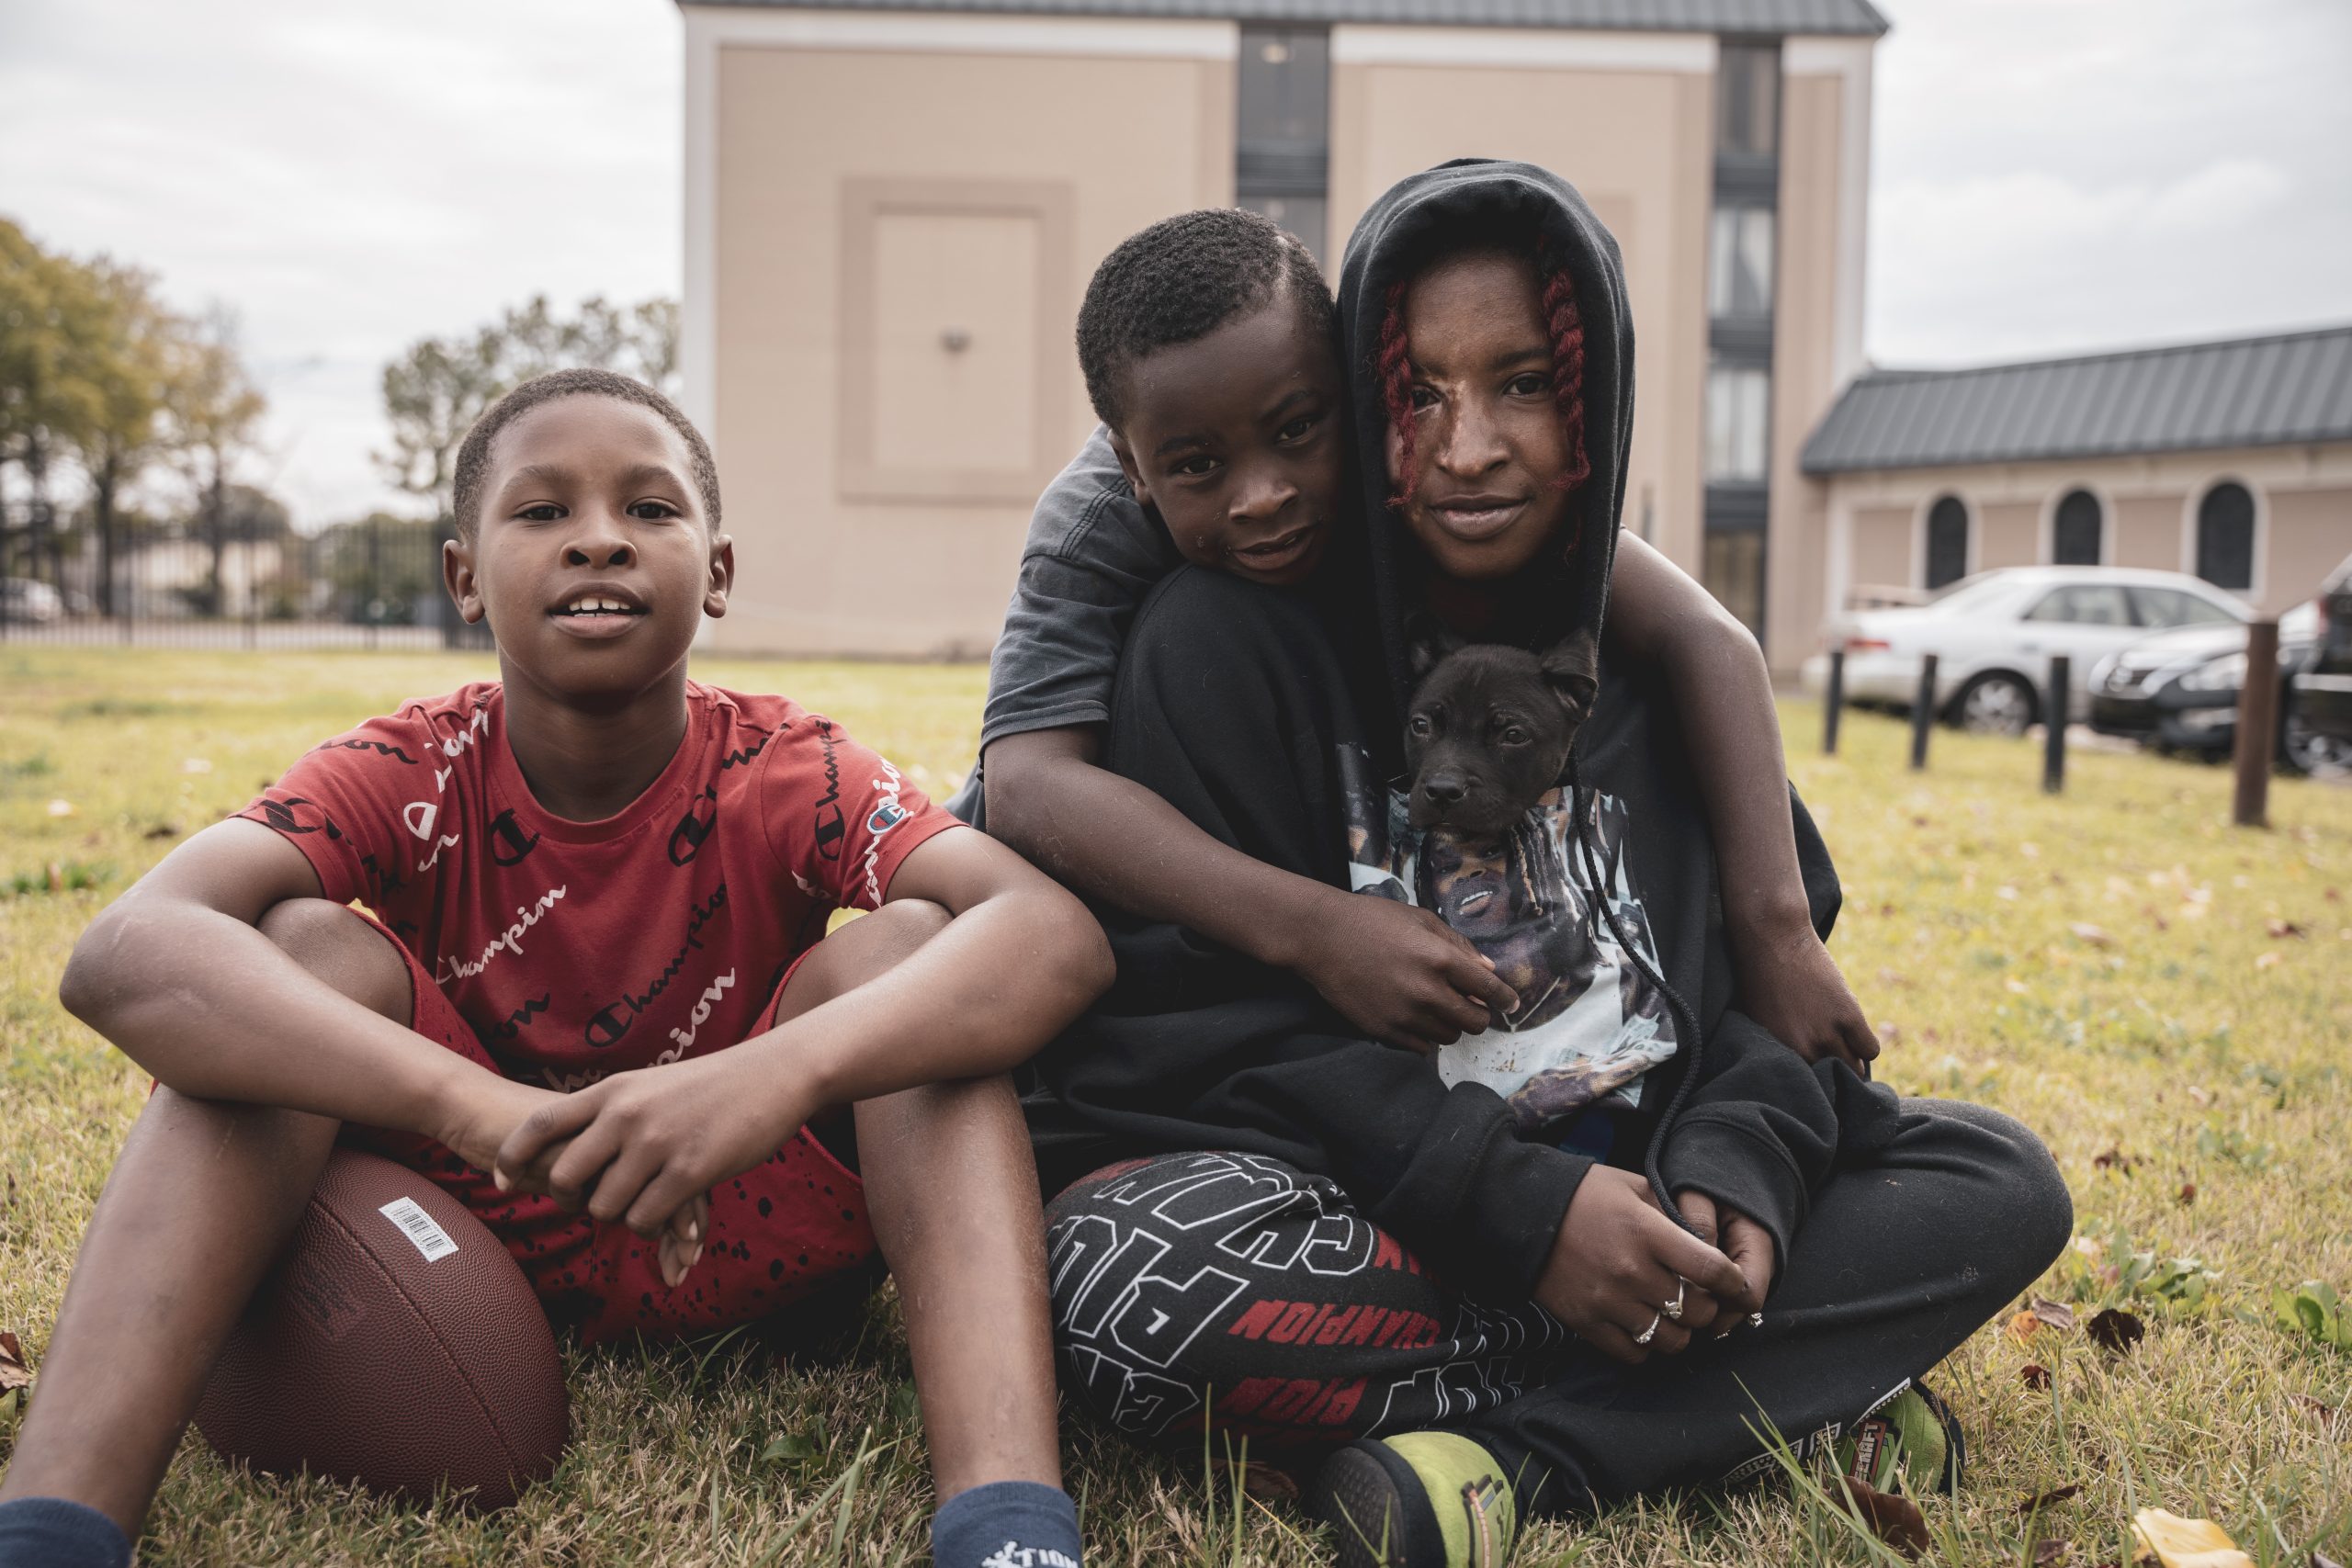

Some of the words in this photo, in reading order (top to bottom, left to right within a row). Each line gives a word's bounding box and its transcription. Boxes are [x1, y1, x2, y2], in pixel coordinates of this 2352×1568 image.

[815, 720, 847, 861] Champi
[584, 884, 727, 1048] Champio
[1228, 1299, 1442, 1350] CHAMPION
[1214, 1378, 1369, 1426] PION
